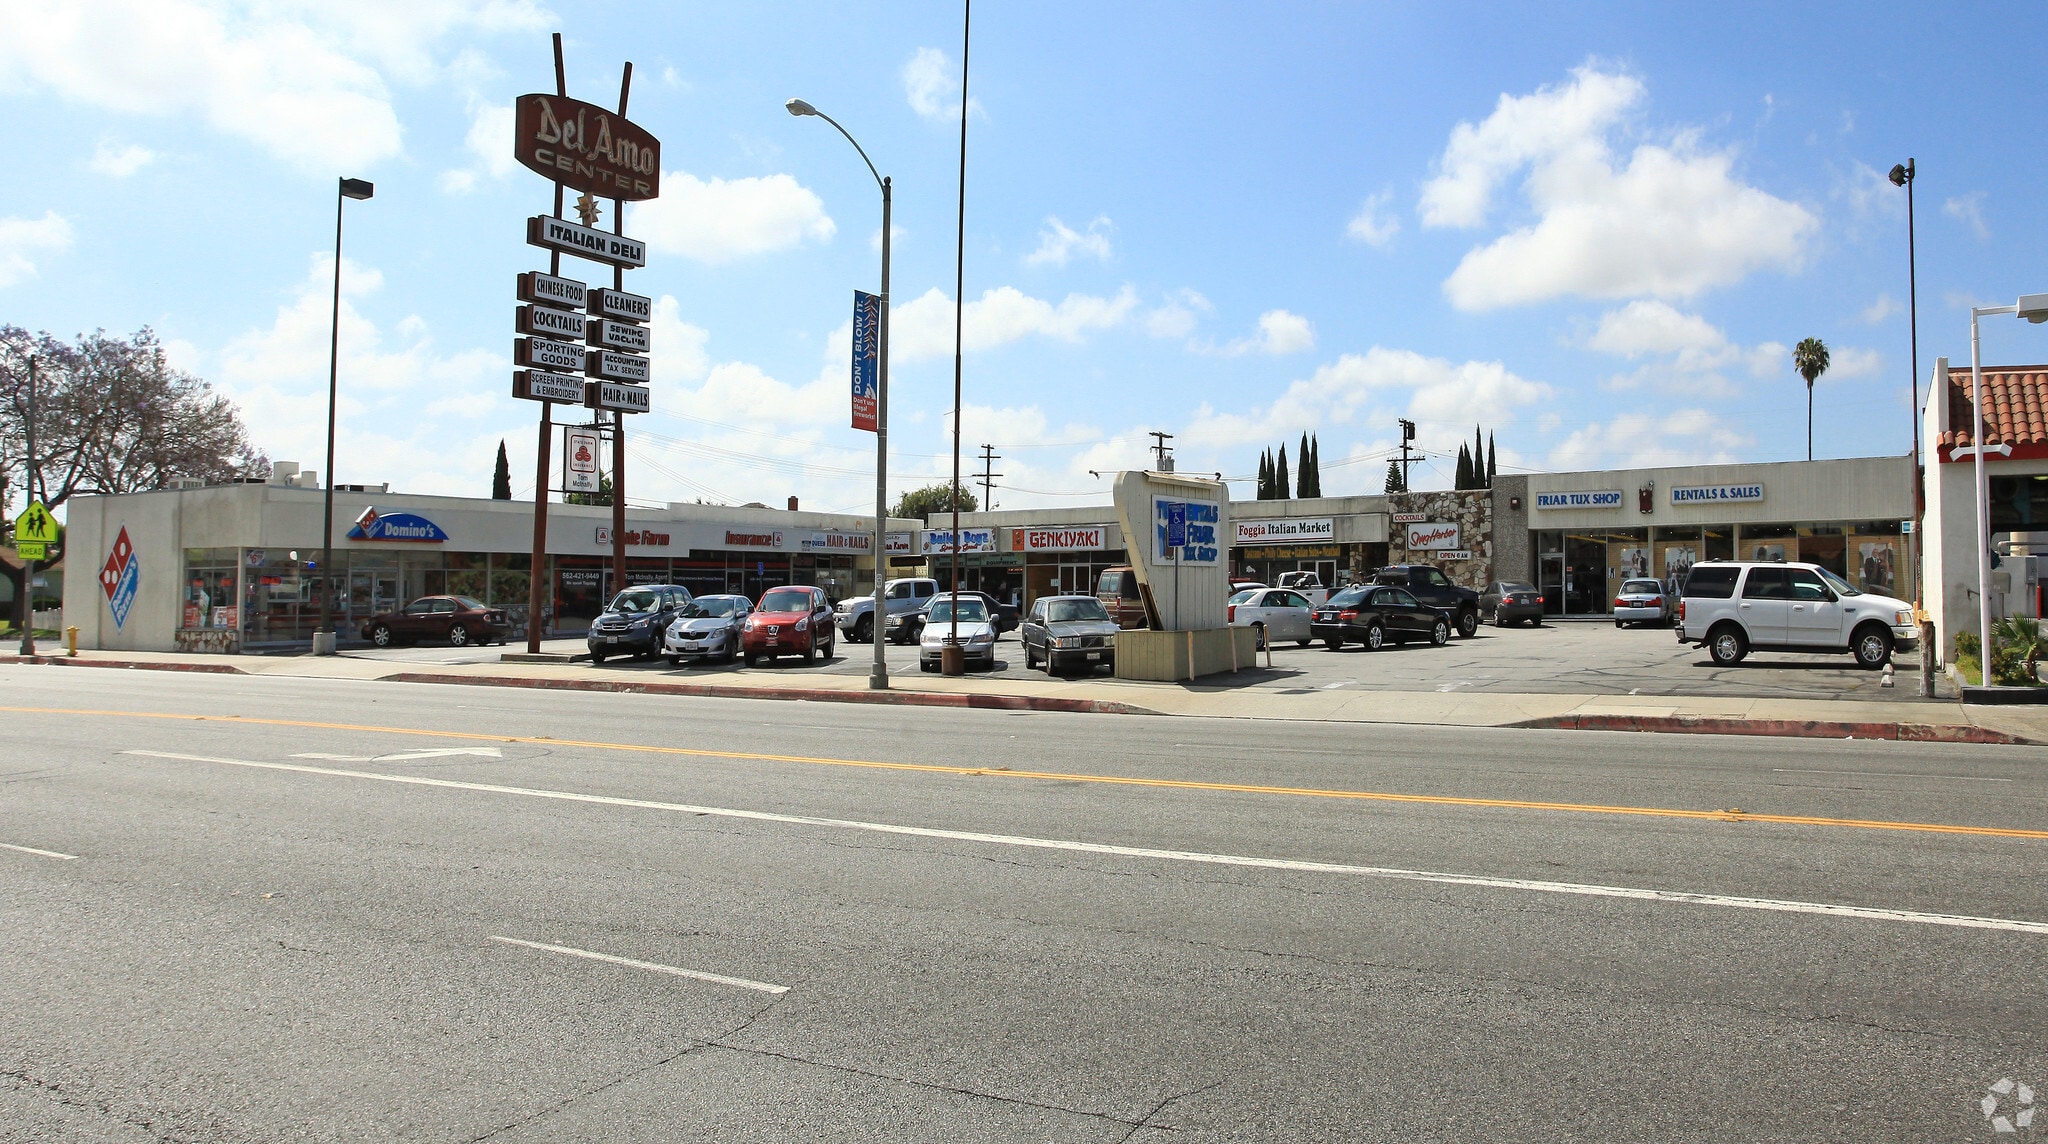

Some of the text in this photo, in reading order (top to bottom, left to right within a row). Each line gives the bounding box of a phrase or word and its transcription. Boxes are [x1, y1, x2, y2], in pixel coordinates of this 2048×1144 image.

[533, 97, 654, 176] Del Amo
[535, 148, 651, 195] CENTER
[550, 224, 641, 260] ITALIAN DELI
[537, 278, 583, 301] CHINESE FOOD
[605, 295, 648, 316] CLEANERS
[534, 310, 582, 333] COCKTAILS
[855, 318, 863, 352] BLOW
[533, 341, 584, 357] SPORTING
[541, 353, 576, 366] GOODS
[605, 355, 647, 368] ACCOUNTANT
[607, 364, 645, 377] TAX SERVICE
[854, 355, 862, 394] DON'T
[531, 374, 583, 389] SCREEN PRINTING
[542, 386, 579, 399] EMBROIDERY
[602, 387, 648, 407] HAIR & NAILS
[1537, 493, 1620, 506] FRIAR TUX SHOP
[1673, 486, 1760, 501] RENTALS & SALES
[385, 522, 435, 537] Domino's
[642, 530, 670, 545] Farm
[1238, 522, 1330, 538] Foggia Italian Market
[725, 530, 772, 546] Insurance
[827, 534, 844, 547] HAIR
[849, 535, 869, 549] NAILS
[1029, 531, 1099, 547] GENKIYAKI
